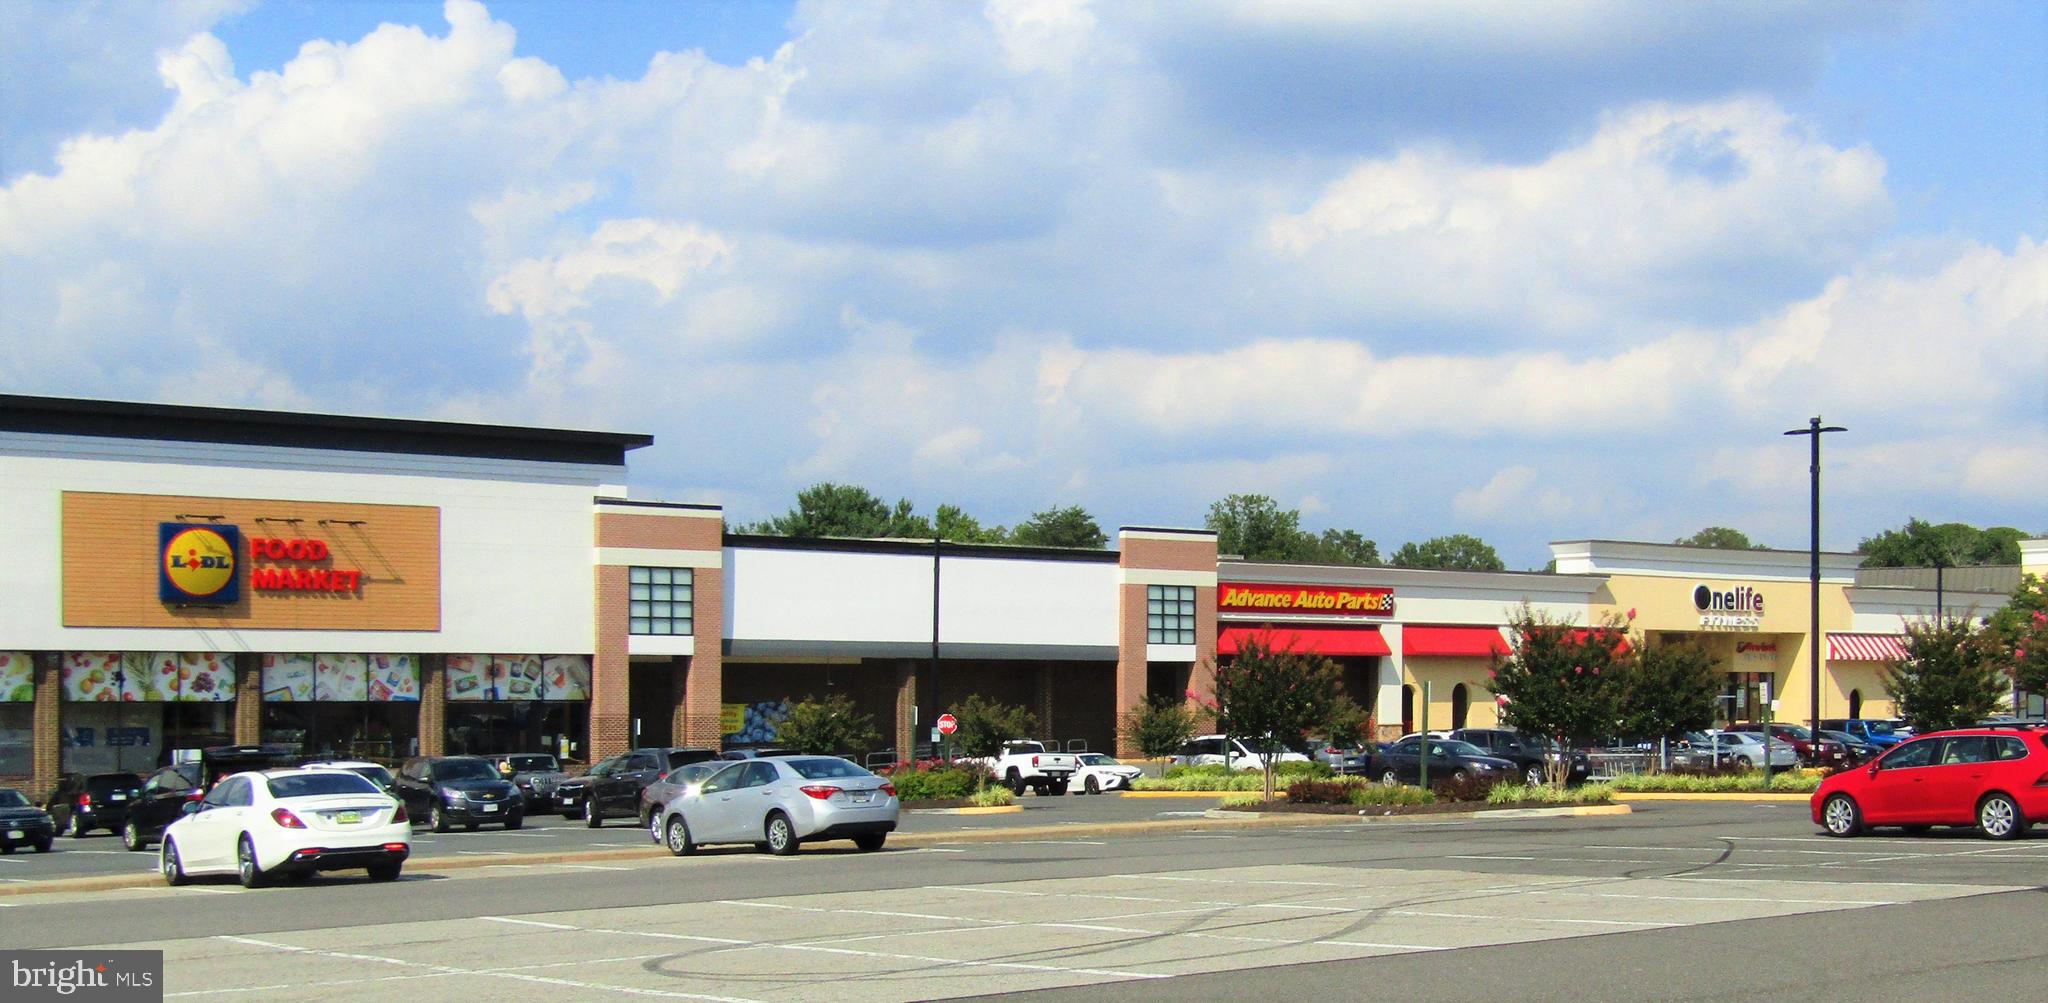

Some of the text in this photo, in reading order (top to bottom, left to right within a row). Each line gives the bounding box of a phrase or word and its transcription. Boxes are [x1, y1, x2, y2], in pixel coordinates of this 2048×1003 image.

[251, 538, 328, 561] FOOD
[252, 568, 361, 592] MARKET
[1222, 588, 1379, 609] Advance Auto Parts
[1693, 584, 1764, 612] Onelife
[939, 720, 956, 728] STOP
